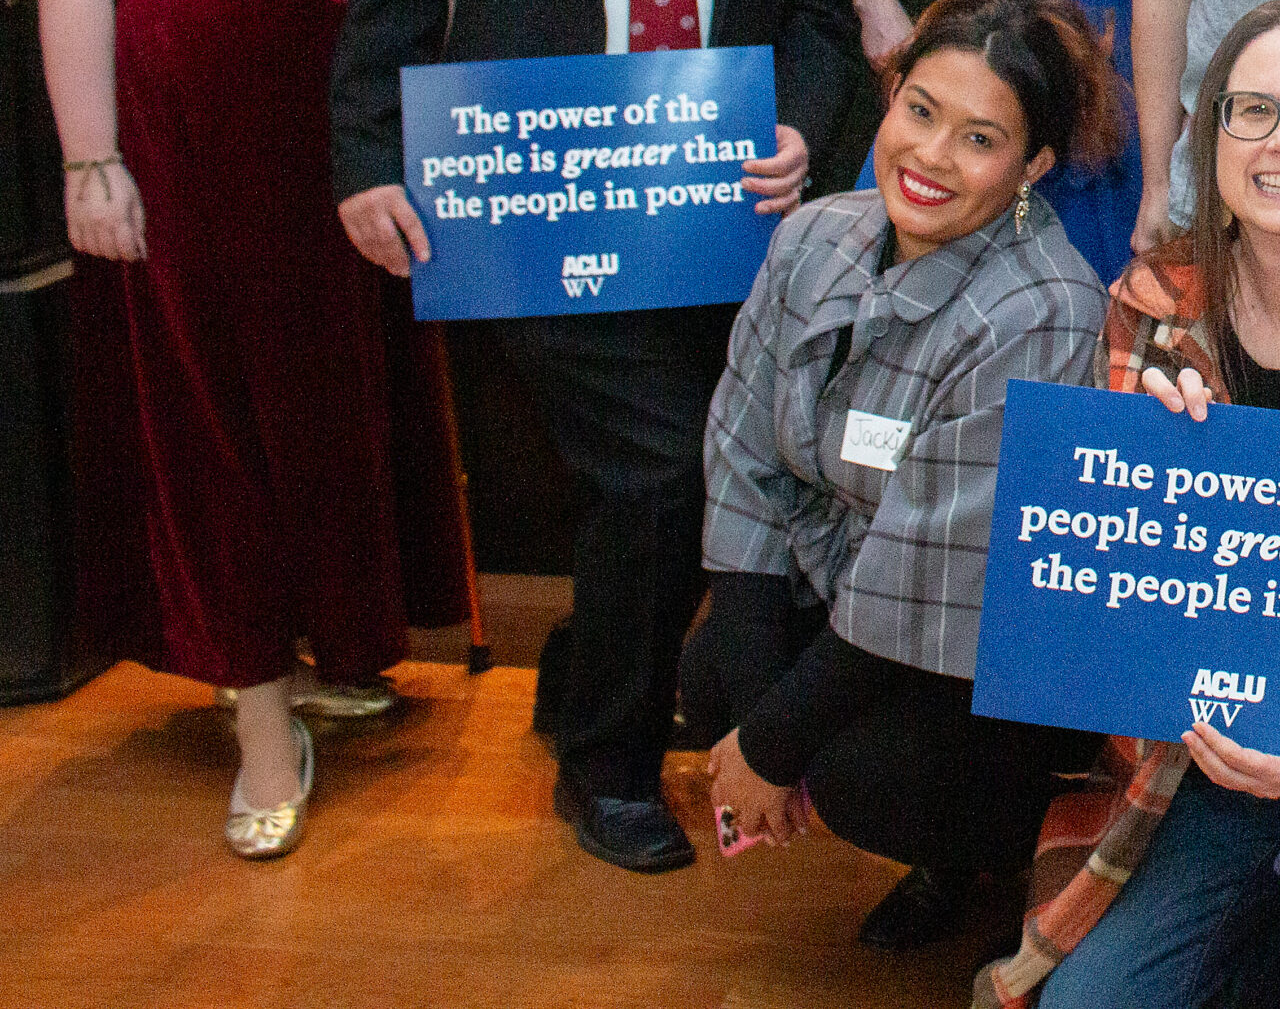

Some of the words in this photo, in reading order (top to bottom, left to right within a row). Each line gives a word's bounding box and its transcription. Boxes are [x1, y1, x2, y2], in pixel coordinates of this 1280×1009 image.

[451, 105, 511, 135] The
[516, 106, 617, 139] power
[623, 95, 662, 125] of
[665, 93, 718, 123] the
[422, 146, 523, 186] people
[529, 143, 557, 172] is
[560, 142, 677, 179] greater
[682, 133, 756, 163] than
[434, 191, 482, 220] the
[488, 184, 596, 224] people
[604, 180, 638, 209] in
[644, 181, 744, 215] power
[562, 253, 619, 277] ACLU
[562, 277, 605, 297] WV
[1074, 447, 1155, 490] The
[1018, 504, 1163, 551] people
[1172, 512, 1208, 552] is
[1030, 553, 1097, 594] the
[1106, 571, 1252, 618] people
[1190, 668, 1267, 703] ACLU
[1189, 698, 1244, 728] WV
